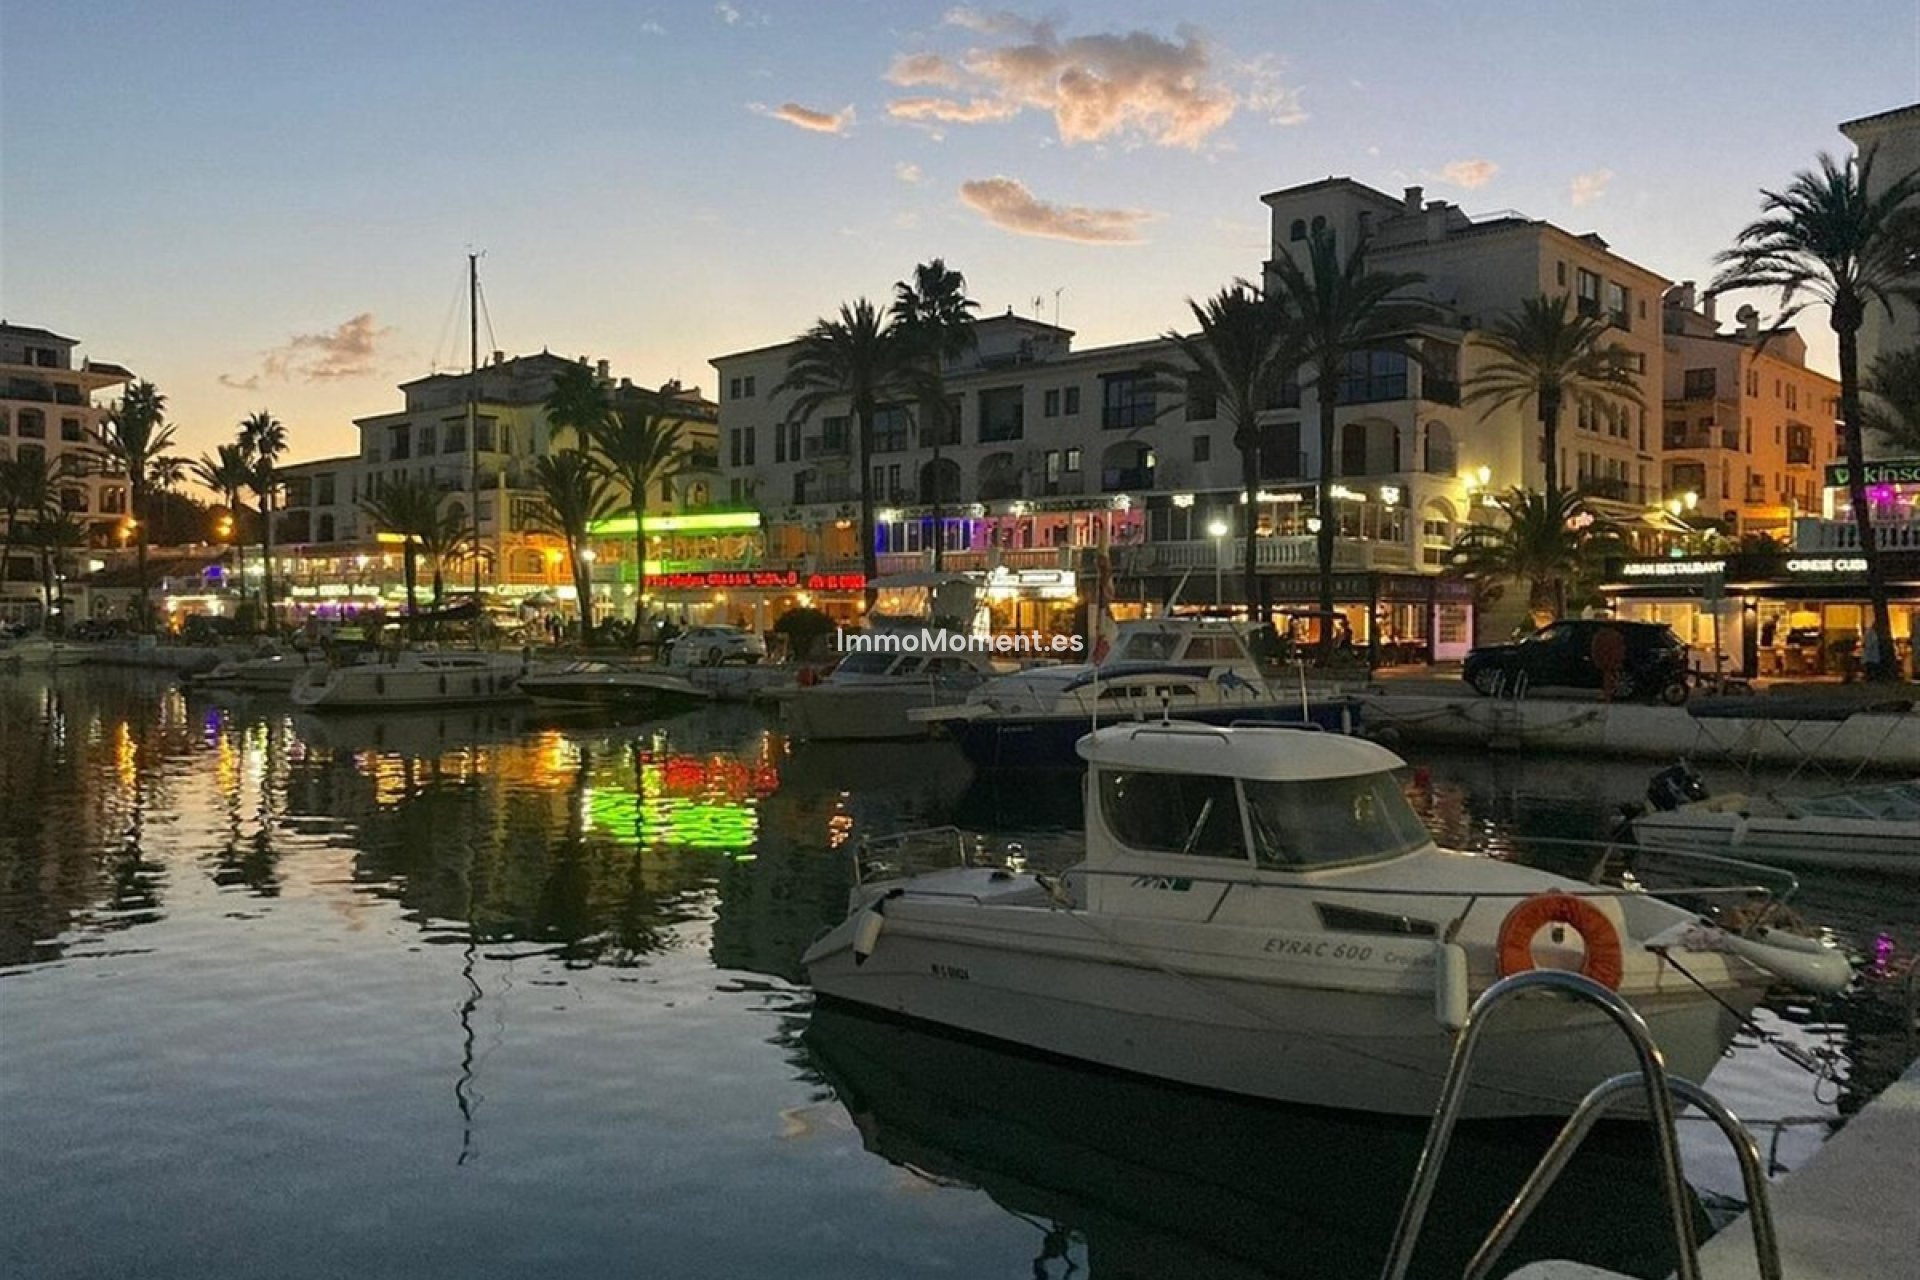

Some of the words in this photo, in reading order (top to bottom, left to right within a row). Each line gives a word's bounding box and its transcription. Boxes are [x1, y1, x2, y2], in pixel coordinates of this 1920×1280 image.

[1655, 561, 1726, 576] RESTAURANT
[1264, 938, 1328, 957] EYRAC
[1333, 943, 1373, 961] 600
